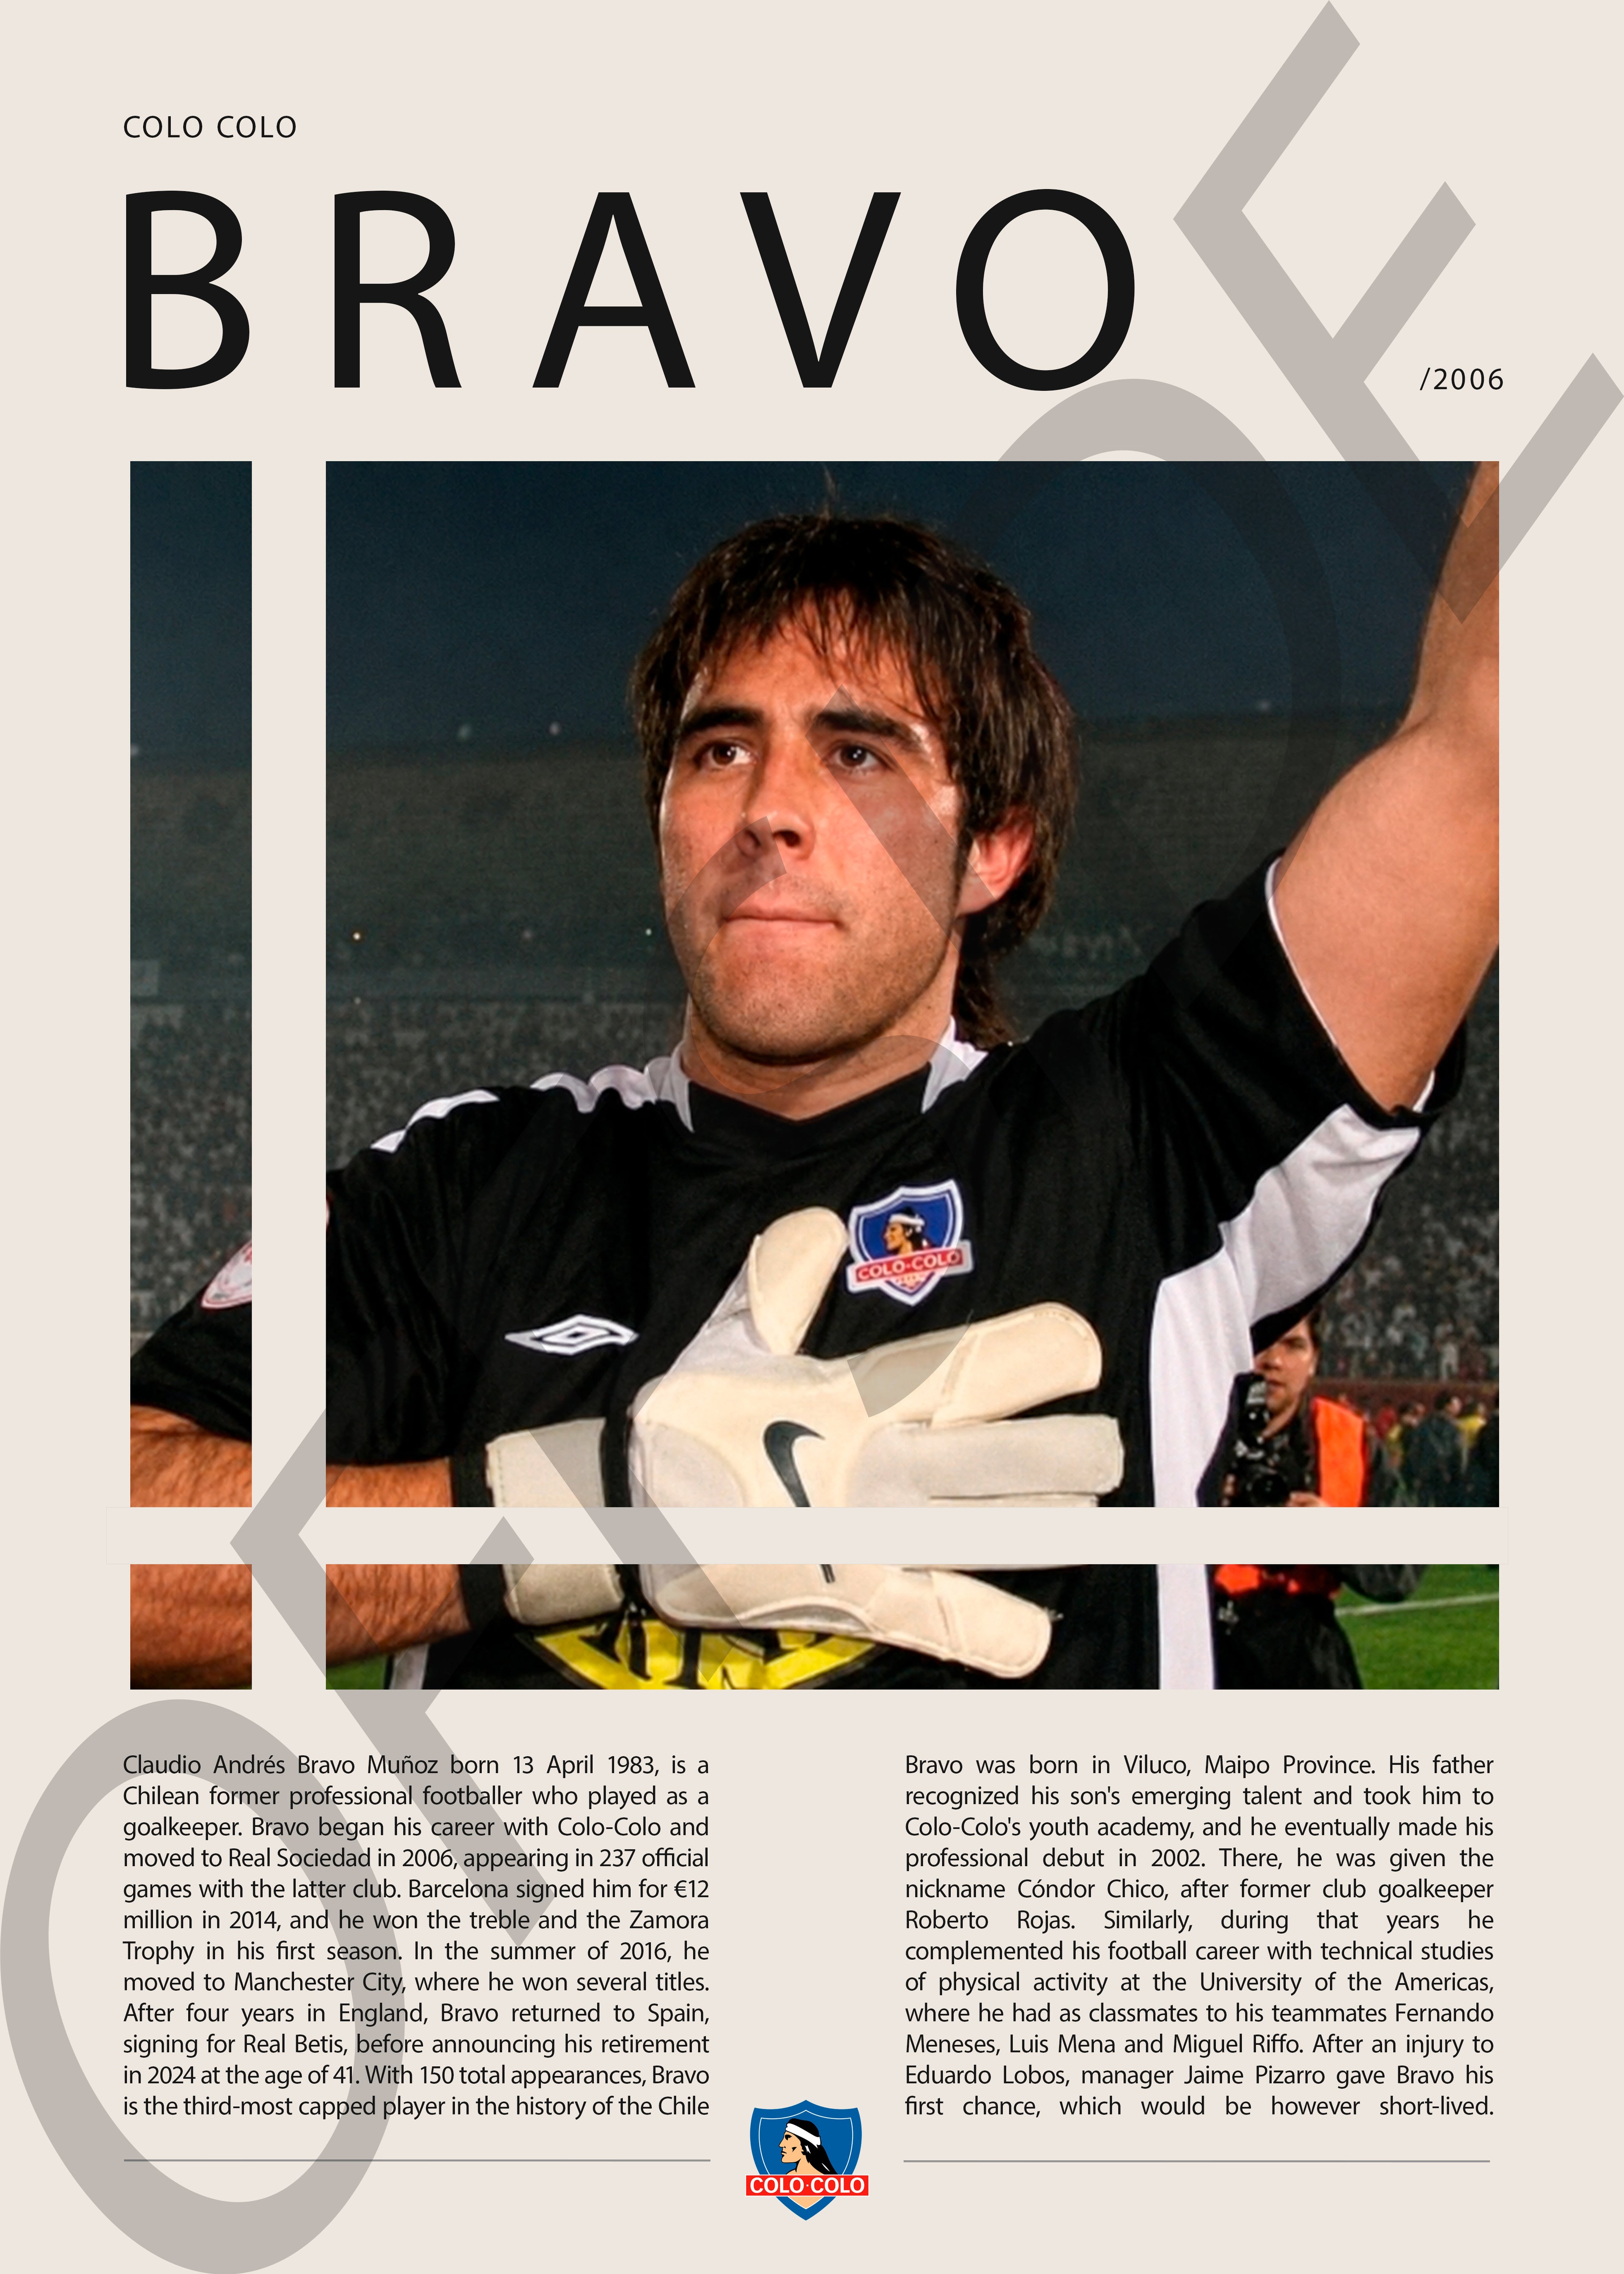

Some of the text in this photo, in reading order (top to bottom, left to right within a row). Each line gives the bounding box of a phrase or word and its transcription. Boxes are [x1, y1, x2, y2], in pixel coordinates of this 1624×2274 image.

[123, 115, 296, 139] COLO COLO
[126, 188, 1135, 392] BRAVO
[1419, 367, 1503, 391] /2006
[123, 1754, 708, 1779] Claudio Andrés Bravo Muñoz born 13 April 1983, is a
[906, 1754, 1494, 1779] Bravo was born in Viluco, Maipo Province. His father
[123, 1785, 708, 1810] Chilean former professional footballer who played as a
[123, 1816, 708, 1841] goalkeeper. Bravo began his career with Colo-Colo and
[905, 1816, 1493, 1841] Colo-Colo's youth academy, and he eventually made his
[906, 1847, 1494, 1872] professional debut in 2002. There, he was given the
[123, 1878, 709, 1903] games with the latter club. Barcelona signed him for €12
[906, 1909, 1494, 1934] Roberto Rojas. Similarly, during that years he
[122, 1940, 709, 1965] Trophy in his first season. In the summer of 2016, he
[905, 1971, 1494, 1996] of physical activity at the University of the Americas,
[123, 2002, 709, 2027] After four years in England, Bravo returned to Spain,
[905, 2002, 1494, 2022] where he had as classmates to his teammates Fernando
[123, 2033, 710, 2058] signing for Real Betis, before announcing his retirement
[906, 2033, 1494, 2058] Meneses, Luis Mena and Miguel Riffo. After an injury to
[124, 2095, 709, 2120] is the third-most capped player in the history of the Chile
[905, 2095, 1493, 2118] first chance, which would be however short-lived.
